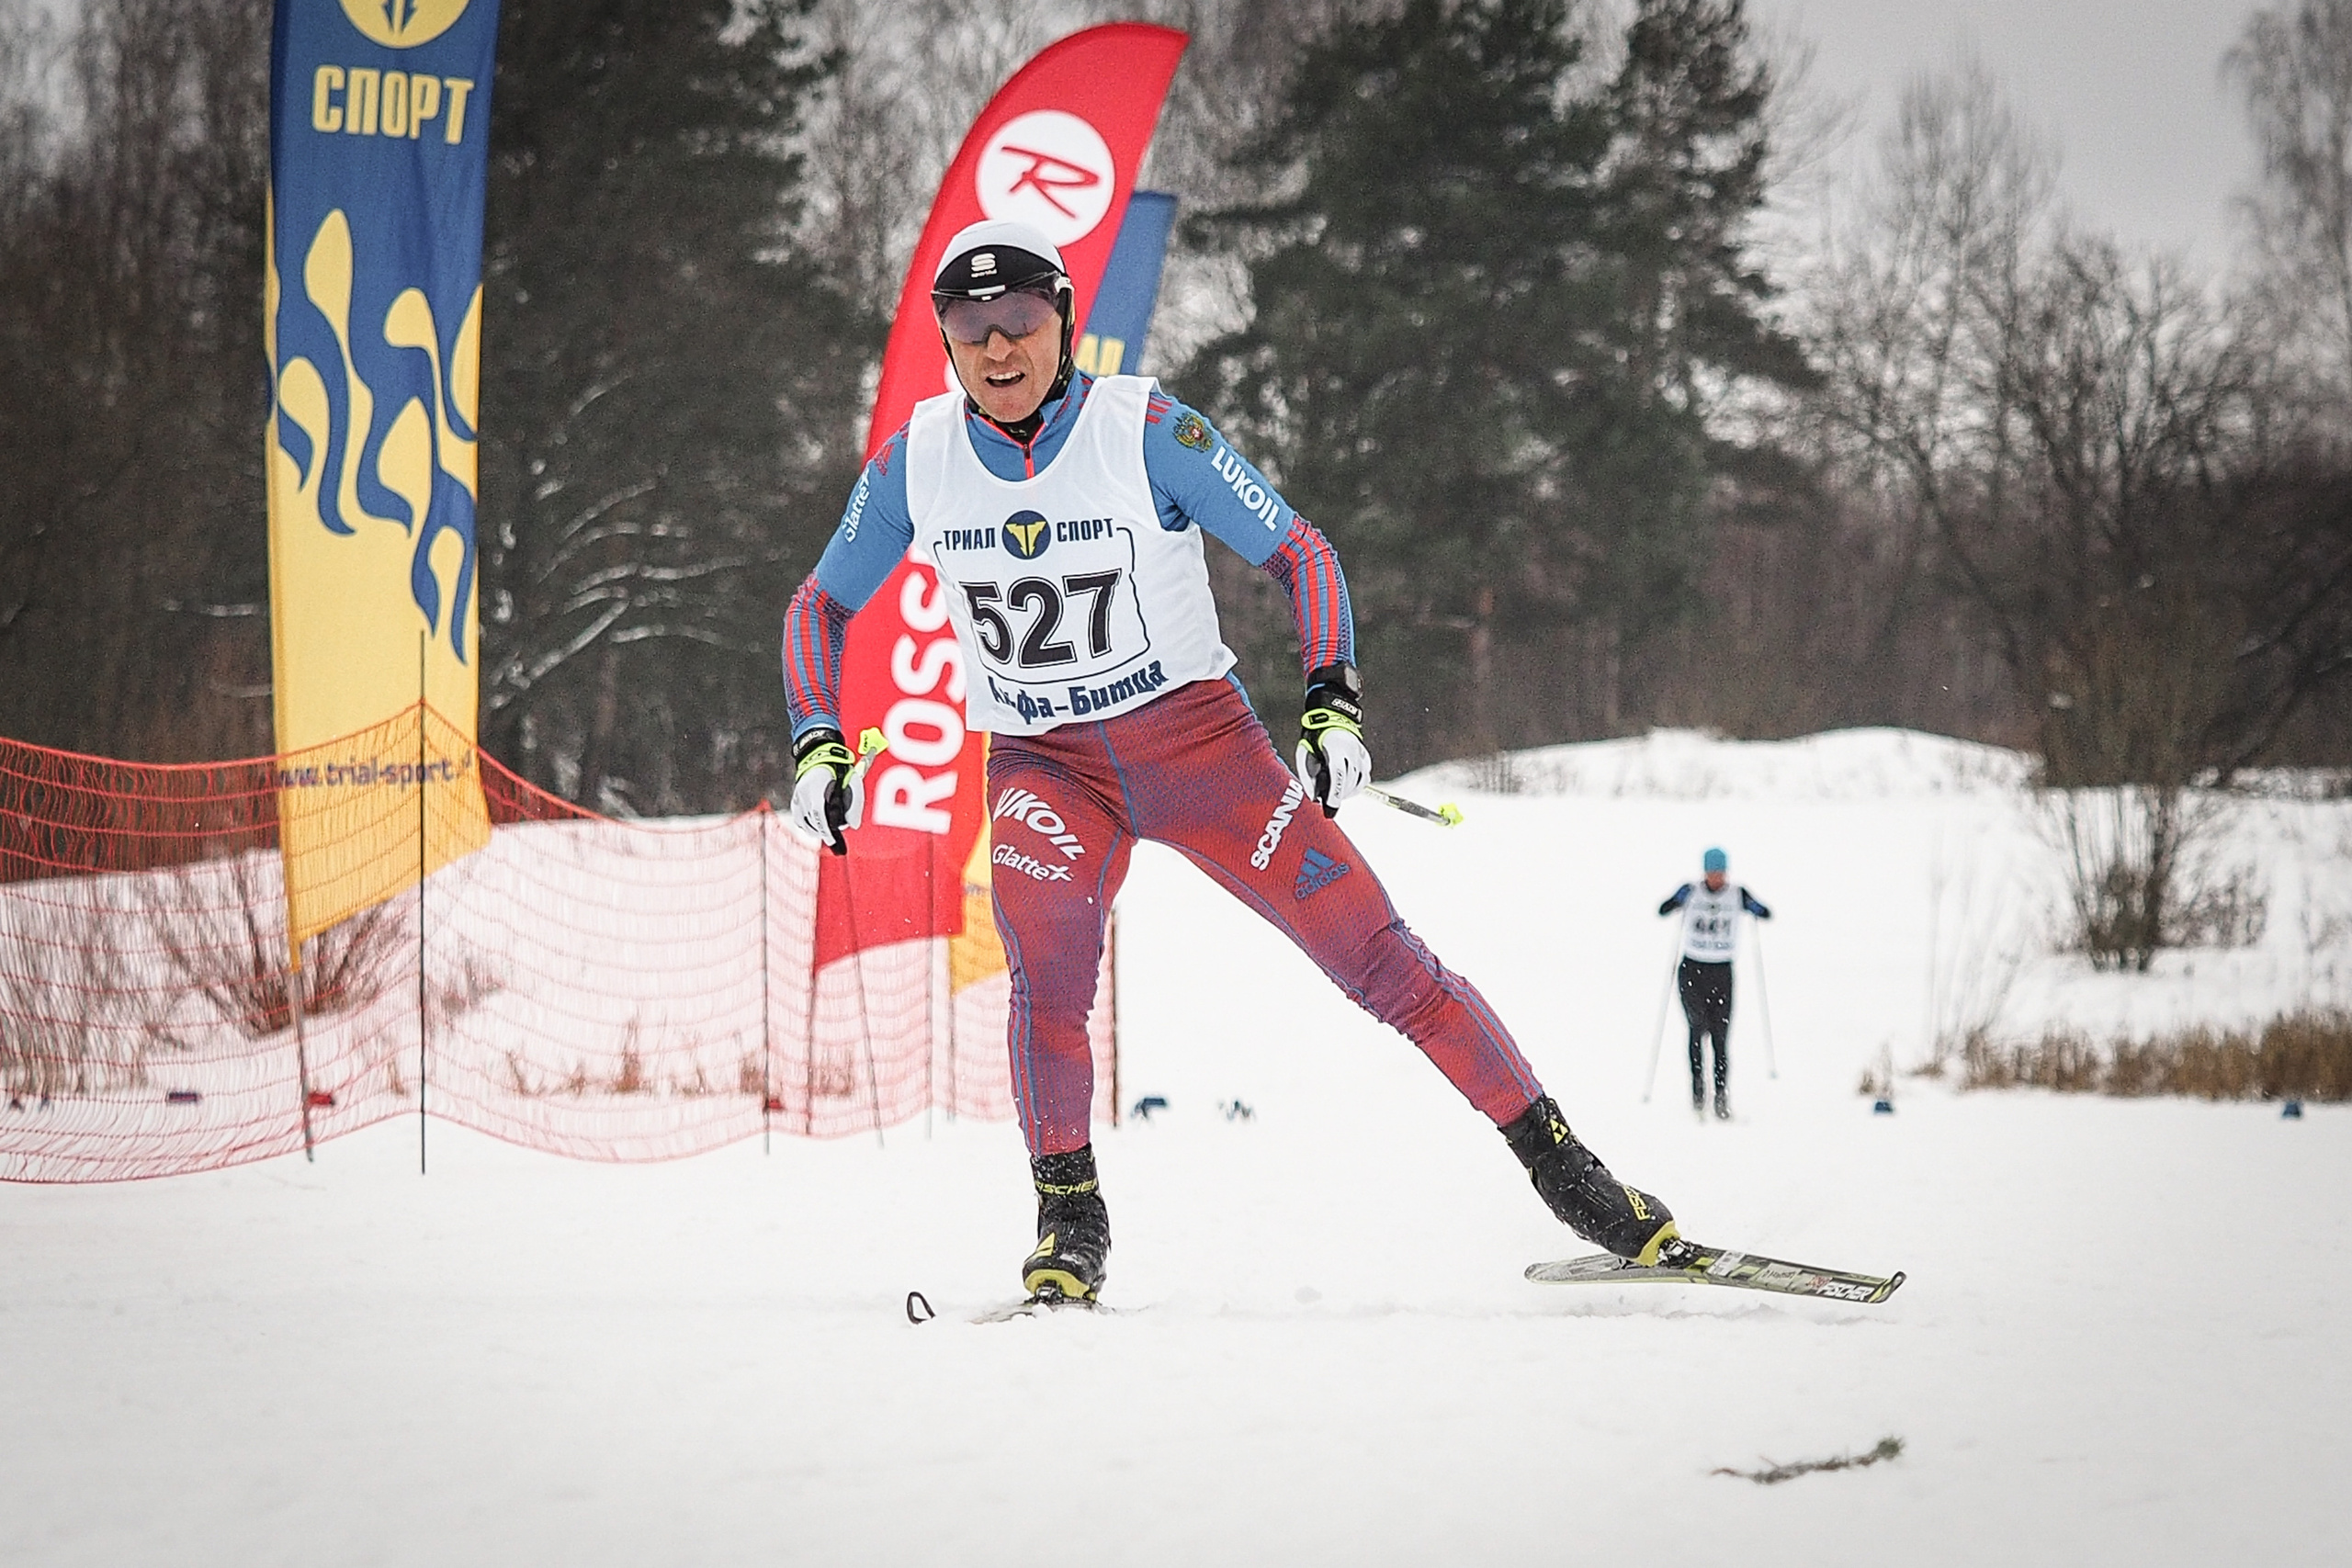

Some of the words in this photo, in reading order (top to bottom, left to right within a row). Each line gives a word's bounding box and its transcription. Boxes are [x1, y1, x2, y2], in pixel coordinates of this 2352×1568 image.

[312, 64, 474, 145] СПОРТ
[1001, 145, 1100, 220] R
[1211, 446, 1280, 532] LUKOIL
[943, 527, 996, 551] ТРИАЛ
[1057, 518, 1114, 543] СПОРТ
[958, 568, 1123, 669] 527
[1295, 862, 1351, 899] adidas
